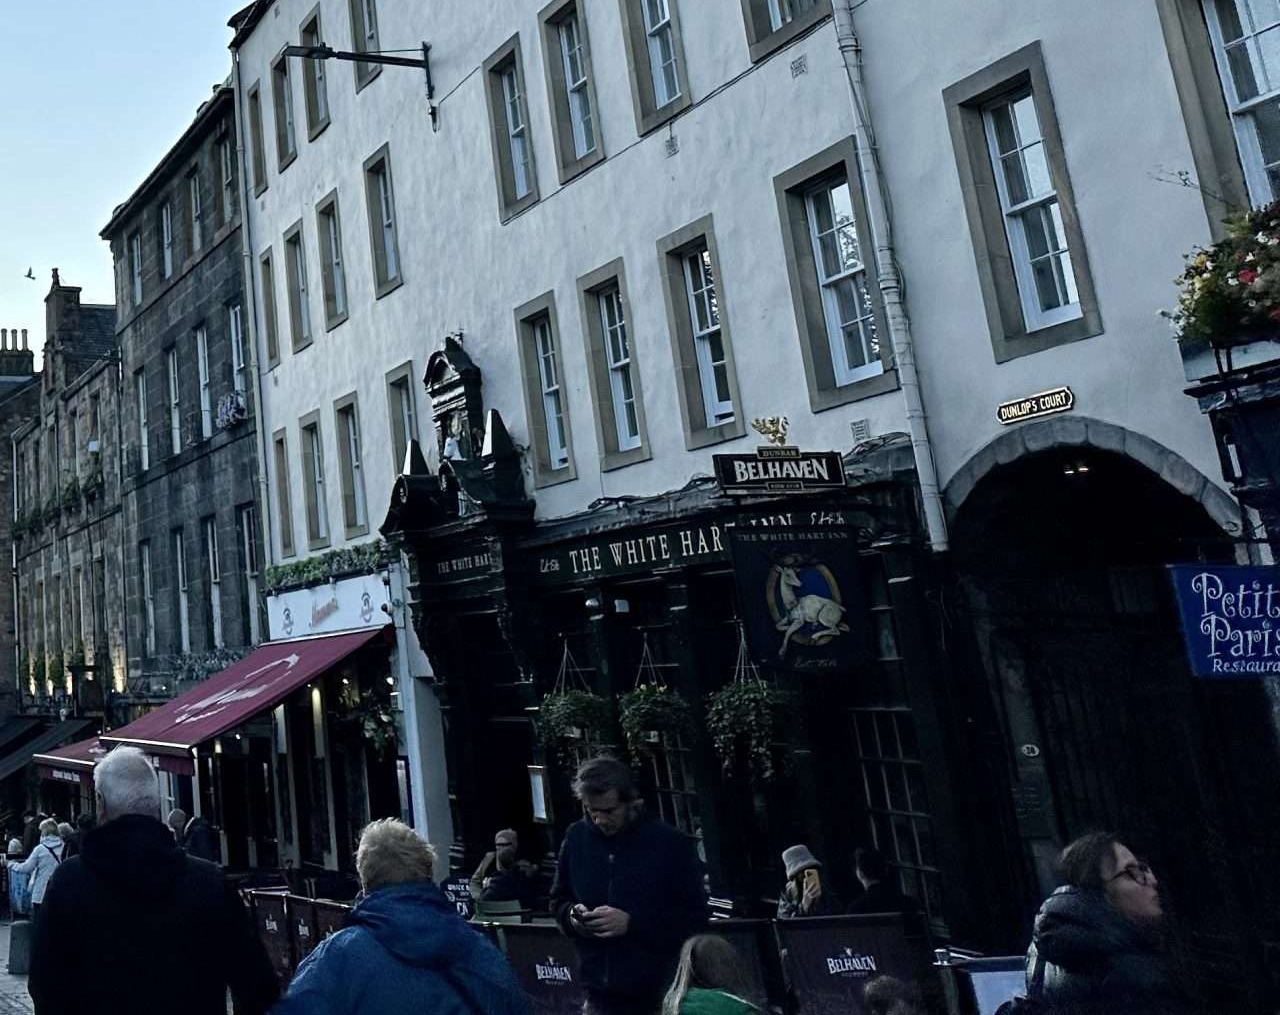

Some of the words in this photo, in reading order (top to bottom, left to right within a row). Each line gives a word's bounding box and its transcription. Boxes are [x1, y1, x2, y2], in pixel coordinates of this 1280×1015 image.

[1001, 399, 1037, 420] DUNLOP'S
[1040, 392, 1066, 410] COURT
[733, 458, 830, 483] BELHAVEN
[760, 532, 795, 541] WHITE
[451, 556, 473, 571] WHITE
[568, 546, 602, 574] THE
[608, 533, 671, 568] WHITE
[826, 955, 877, 975] BELHAVEN
